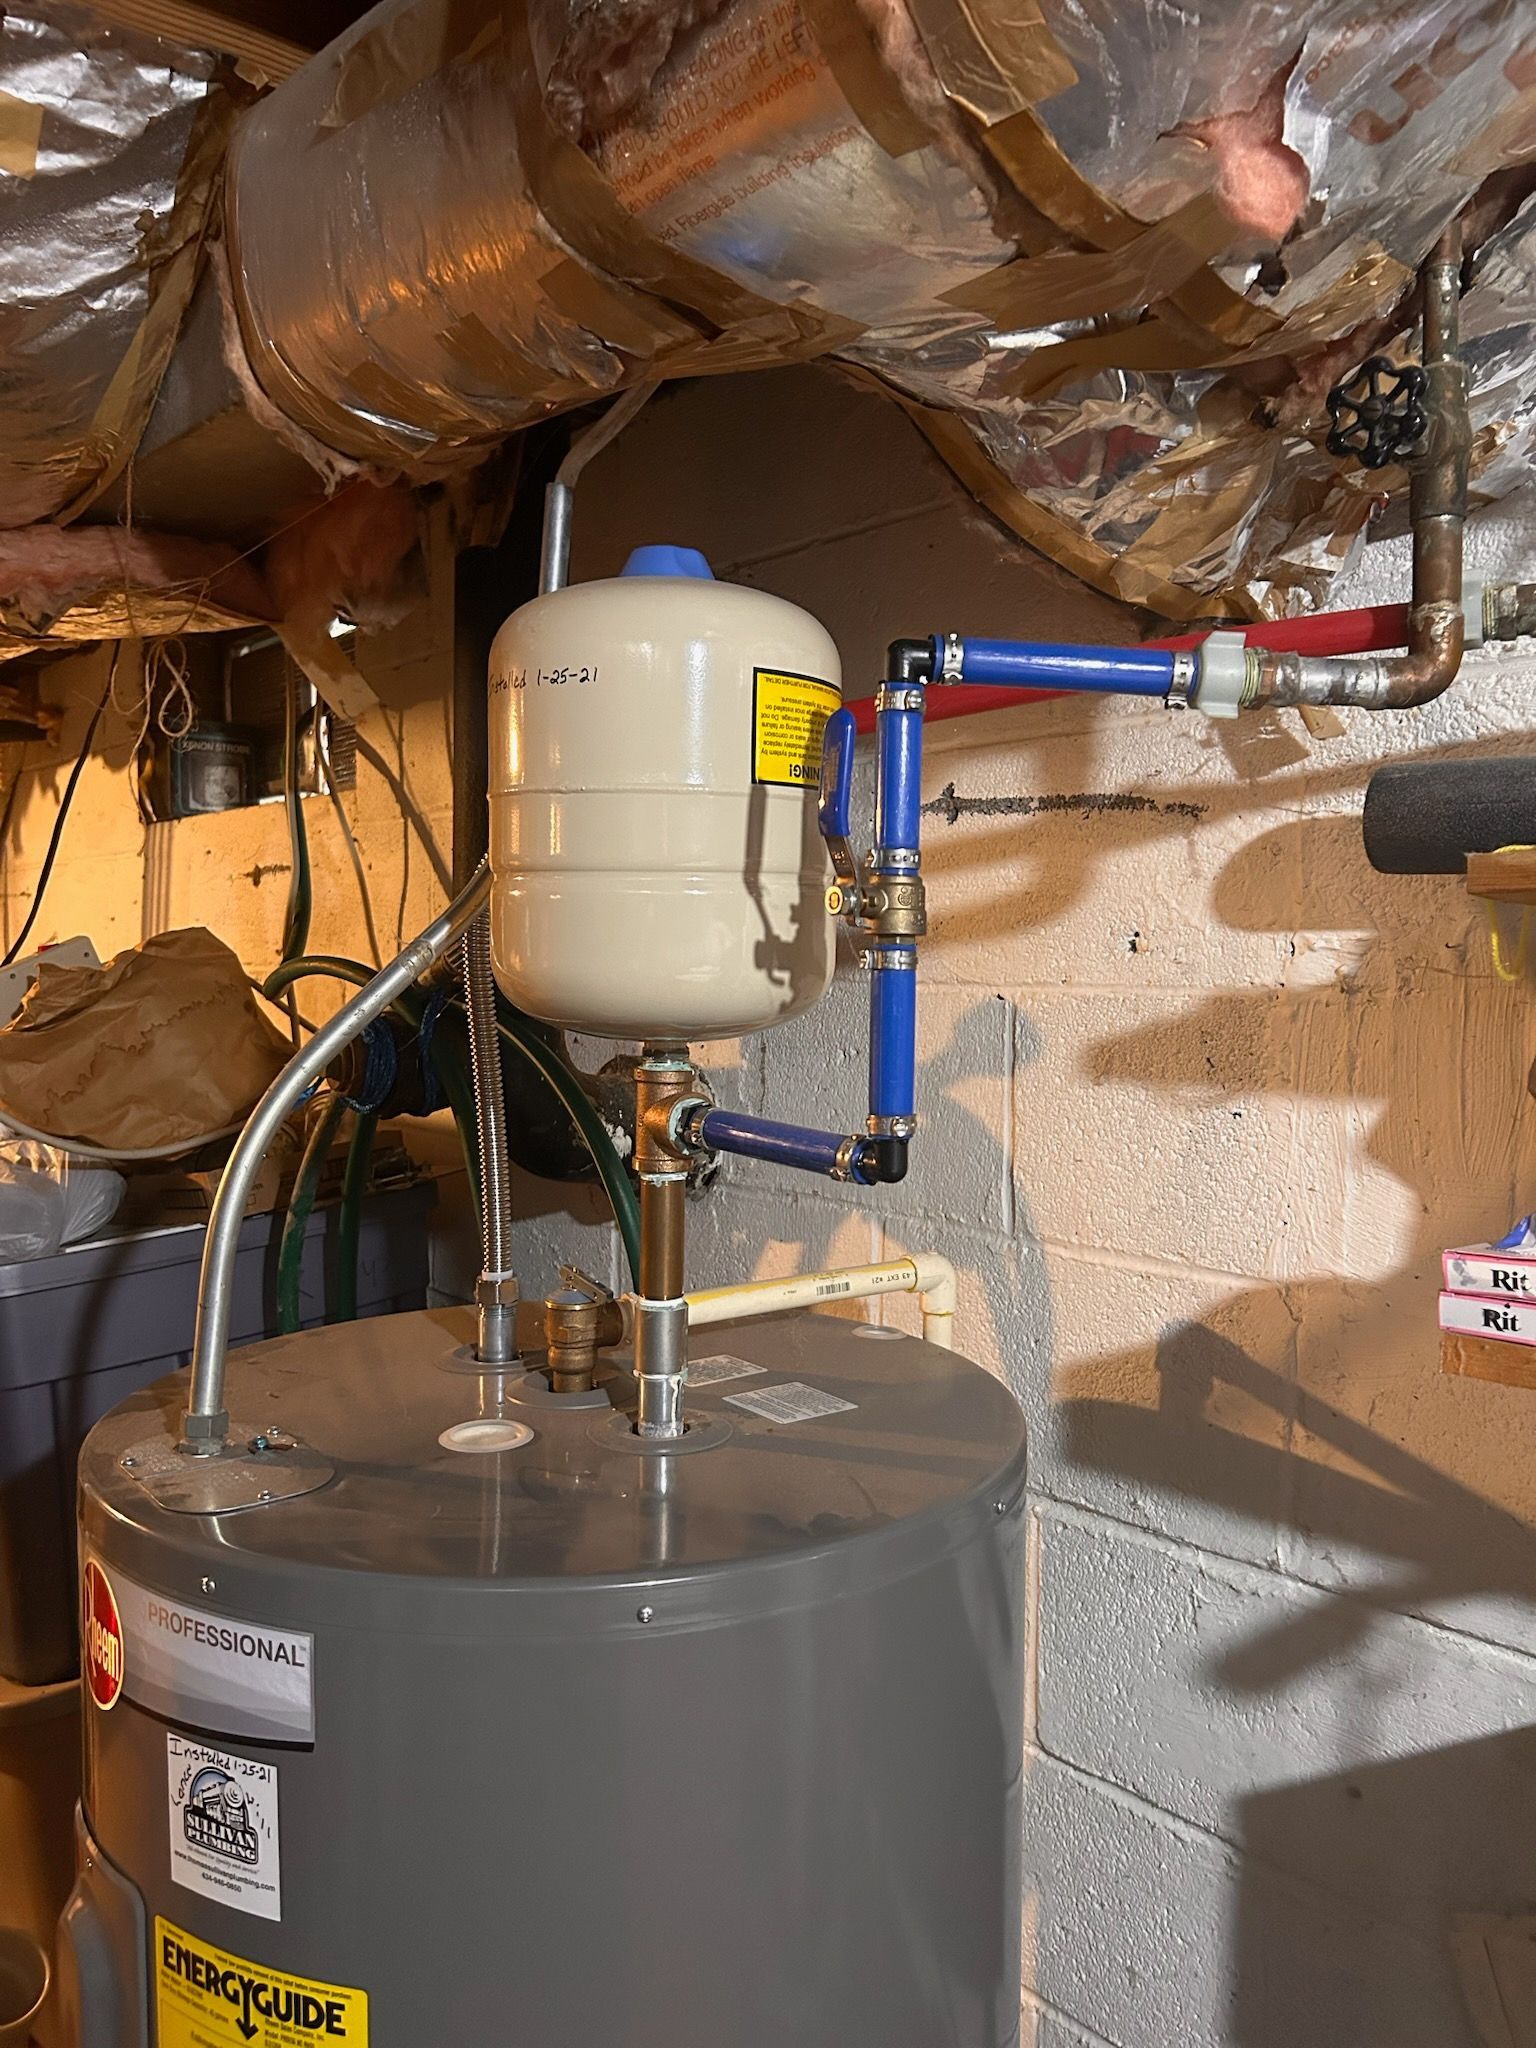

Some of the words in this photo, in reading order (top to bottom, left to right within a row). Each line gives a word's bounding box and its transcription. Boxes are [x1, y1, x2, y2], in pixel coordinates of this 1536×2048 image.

[688, 29, 747, 79] FACING
[749, 20, 771, 42] on
[648, 90, 709, 142] SHOULD
[711, 64, 744, 99] NOT
[748, 49, 773, 78] BE
[773, 20, 817, 61] LEFT
[712, 100, 753, 134] when
[752, 60, 817, 107] working
[732, 162, 793, 200] building
[787, 125, 862, 170] insulation
[645, 178, 680, 203] open
[537, 667, 599, 688] 1-25-21
[764, 731, 788, 739] corrosion
[789, 763, 820, 780] NING!
[1490, 1268, 1531, 1291] Rit
[1481, 1308, 1521, 1332] Rit
[148, 1601, 306, 1668] PROFESSIONAL
[169, 1737, 231, 1771] Installed
[186, 1812, 256, 1850] SULLIVAN
[187, 1827, 256, 1861] PLUMBING
[163, 1935, 346, 2037] ENERGYGUIDE
